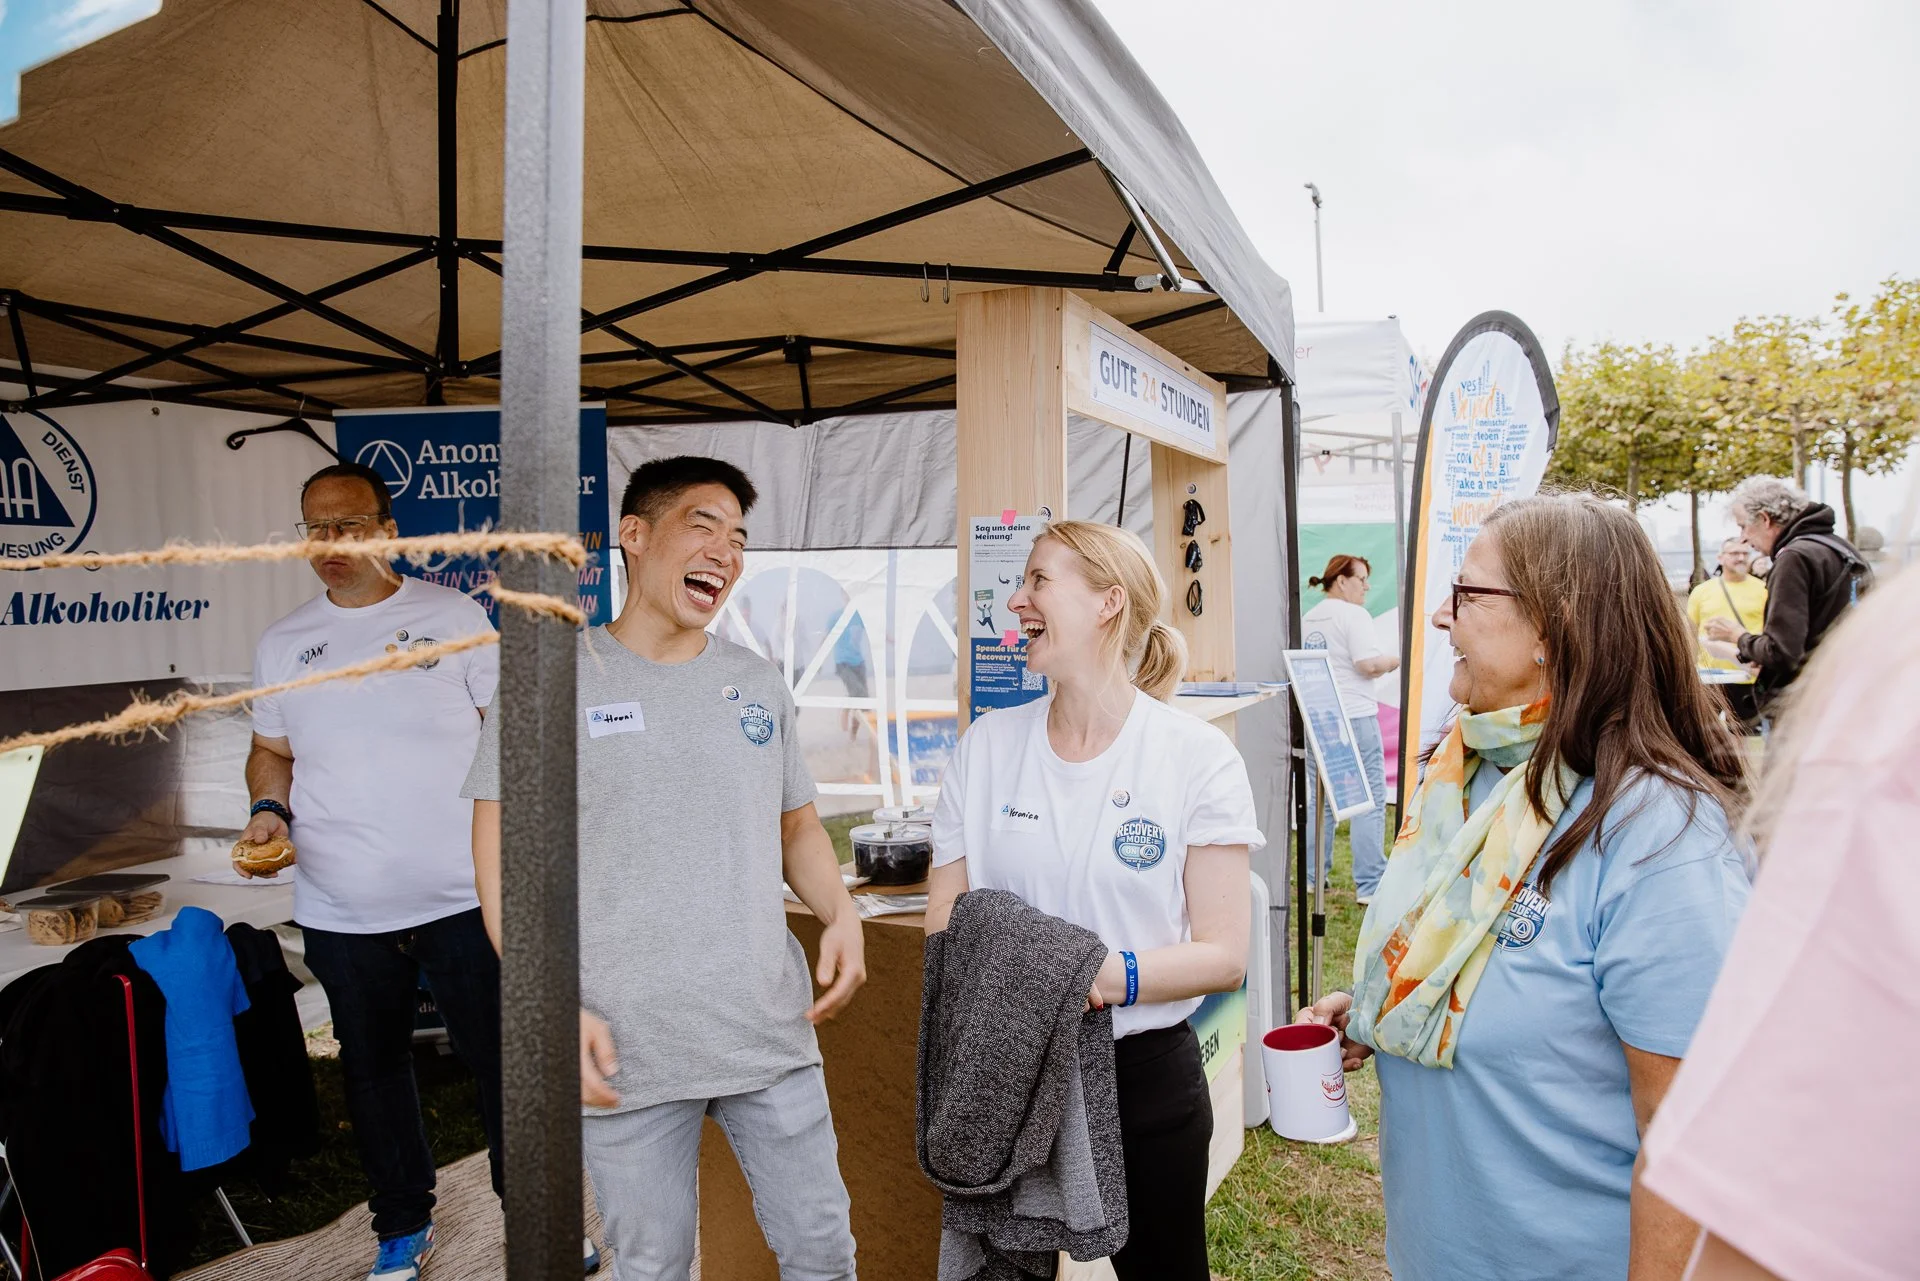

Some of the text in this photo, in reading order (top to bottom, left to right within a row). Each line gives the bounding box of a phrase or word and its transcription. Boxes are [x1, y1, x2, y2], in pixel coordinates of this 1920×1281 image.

[1100, 350, 1210, 432] GUTE 24 STUNDEN
[415, 440, 500, 465] Anon
[41, 431, 85, 494] DIENST
[975, 525, 990, 533] Sag
[975, 532, 1013, 541] Meinung!
[422, 571, 463, 589] DEIN
[0, 590, 210, 626] Alkoholiker
[305, 643, 328, 664] JAN
[976, 653, 1012, 662] Recovery
[741, 707, 772, 722] RECOVERY
[1117, 823, 1164, 840] RECOVERY
[1511, 903, 1533, 918] ODE:
[1516, 888, 1552, 916] OVERY
[1200, 1029, 1220, 1067] EBEN
